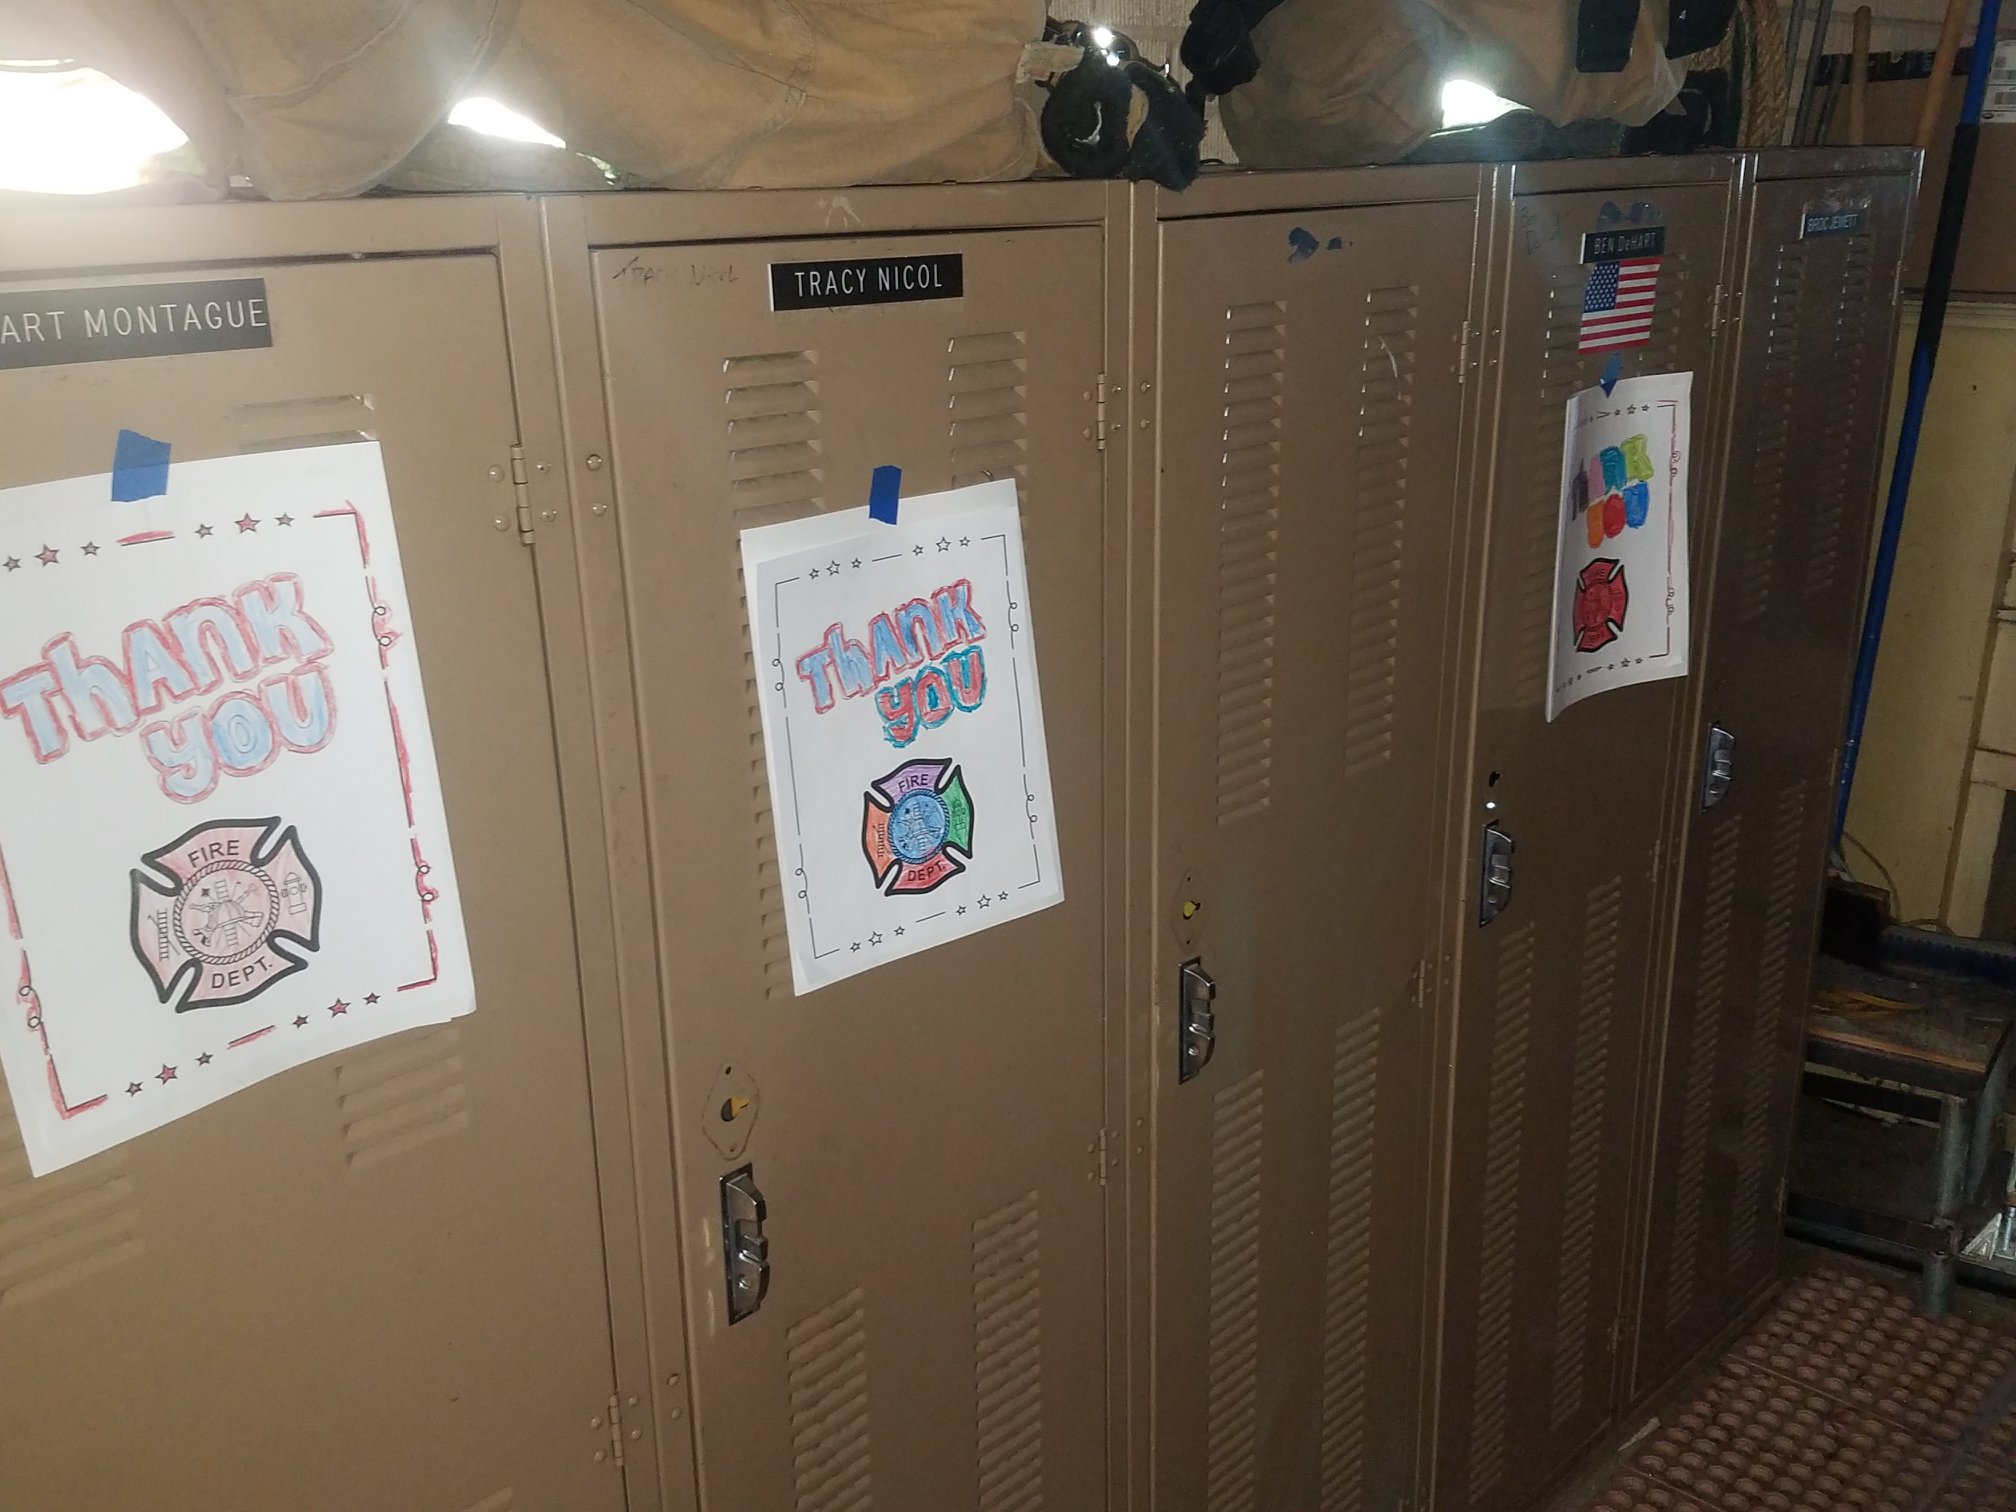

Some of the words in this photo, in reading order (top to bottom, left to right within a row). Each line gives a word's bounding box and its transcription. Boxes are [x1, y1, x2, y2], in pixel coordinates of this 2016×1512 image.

[1593, 237, 1615, 255] BEN
[794, 268, 867, 298] TRACY
[878, 262, 943, 292] NICOL
[0, 310, 66, 344] ART
[84, 298, 268, 338] MONTAGUE
[898, 772, 930, 793] FIRE
[187, 838, 241, 868] FIRE
[907, 859, 947, 882] DEPT.
[210, 955, 274, 990] DEPT.
